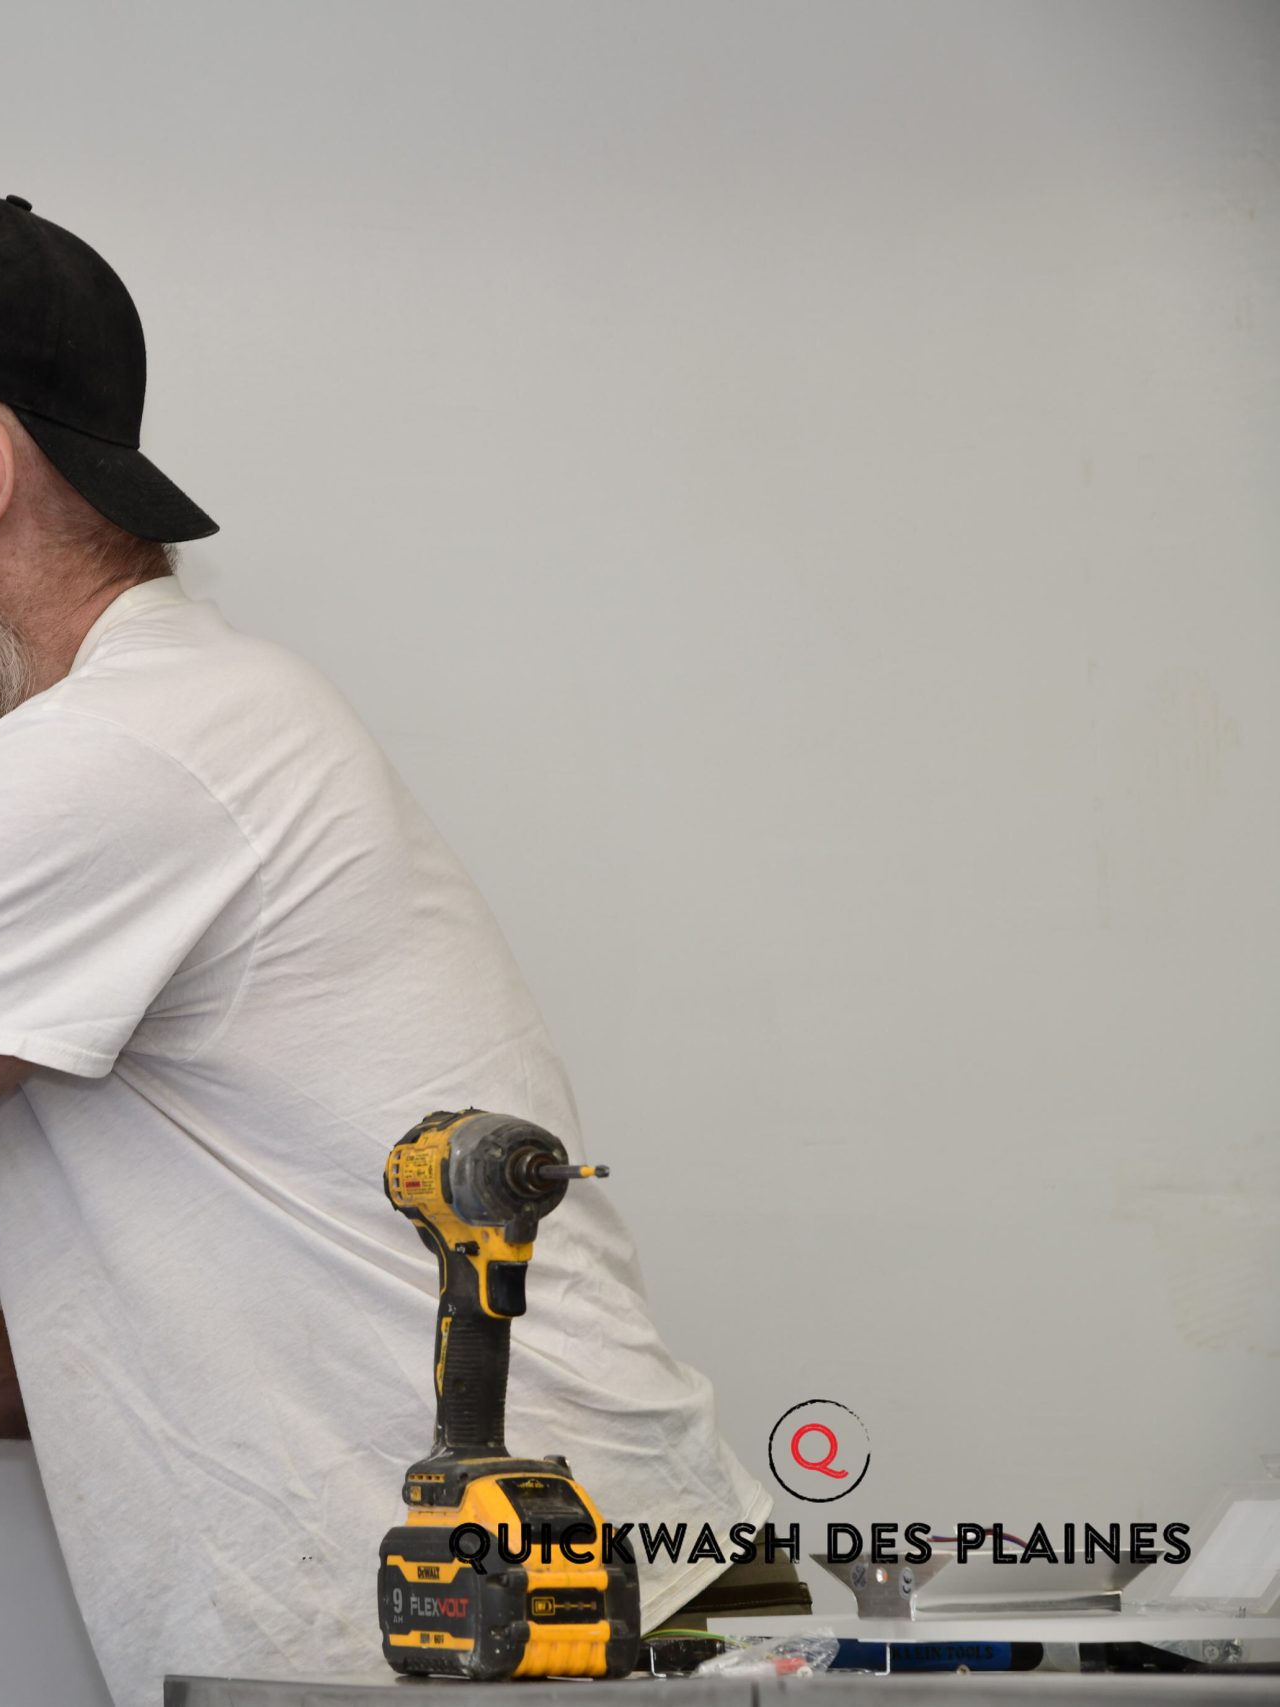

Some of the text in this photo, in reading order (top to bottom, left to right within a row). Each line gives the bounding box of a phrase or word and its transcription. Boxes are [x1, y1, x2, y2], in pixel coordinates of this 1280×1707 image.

[392, 1588, 403, 1614] 9
[410, 1595, 470, 1617] FLEXVOLT
[947, 1646, 993, 1660] TOOLS
